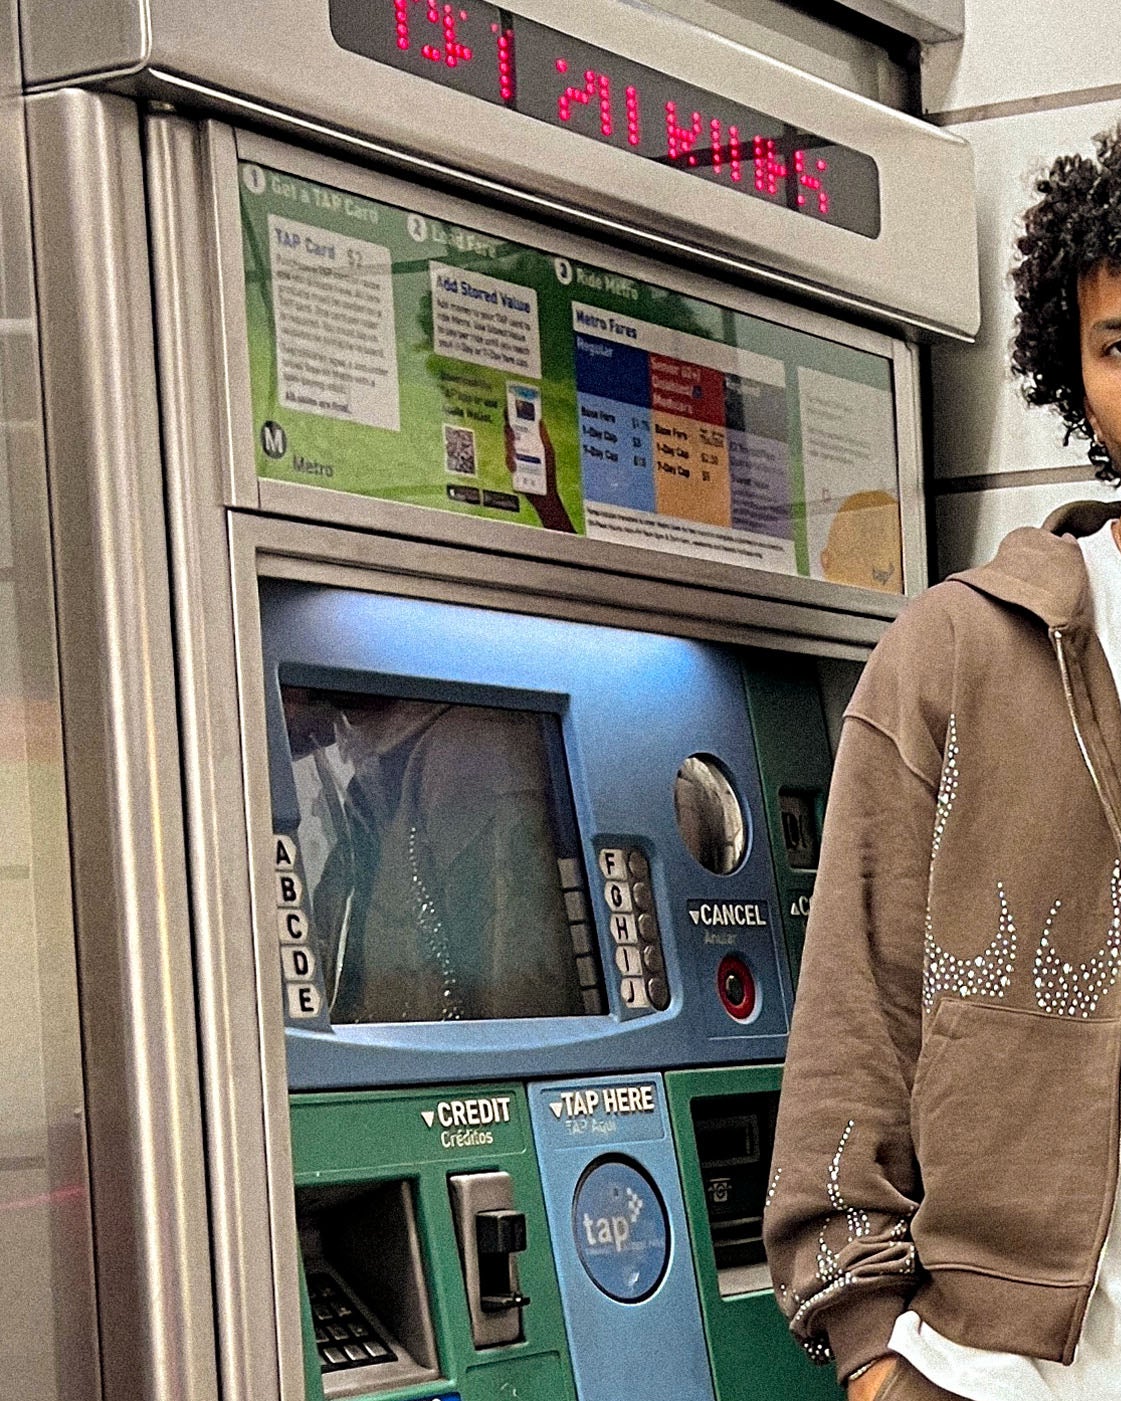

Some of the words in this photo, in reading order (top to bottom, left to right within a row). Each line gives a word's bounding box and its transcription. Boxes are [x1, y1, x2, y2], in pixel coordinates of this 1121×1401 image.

[271, 176, 297, 200] Get
[301, 189, 311, 204] a
[312, 187, 342, 209] TAP
[345, 199, 379, 224] Card
[274, 227, 301, 248] TAP
[305, 237, 336, 260] Card
[437, 275, 459, 294] Add
[461, 281, 499, 305] Stored
[500, 290, 532, 314] Value
[604, 274, 640, 300] Metro
[576, 309, 608, 331] Metro
[608, 318, 638, 339] Fares
[576, 334, 614, 357] Regular
[264, 426, 284, 454] M
[292, 454, 335, 478] Metro
[276, 841, 291, 865] A
[605, 852, 615, 877] F
[281, 878, 296, 902] B
[611, 885, 621, 908] G
[287, 915, 302, 938] C
[700, 903, 767, 926] CANCEL
[616, 917, 628, 939] H
[294, 951, 308, 975] D
[625, 949, 630, 972] I
[300, 988, 314, 1012] E
[626, 981, 635, 1004] J
[436, 1097, 511, 1128] CREDIT
[560, 1090, 599, 1116] TAP
[603, 1087, 655, 1113] HERE
[440, 1127, 494, 1149] Créditos
[582, 1212, 630, 1253] tap
